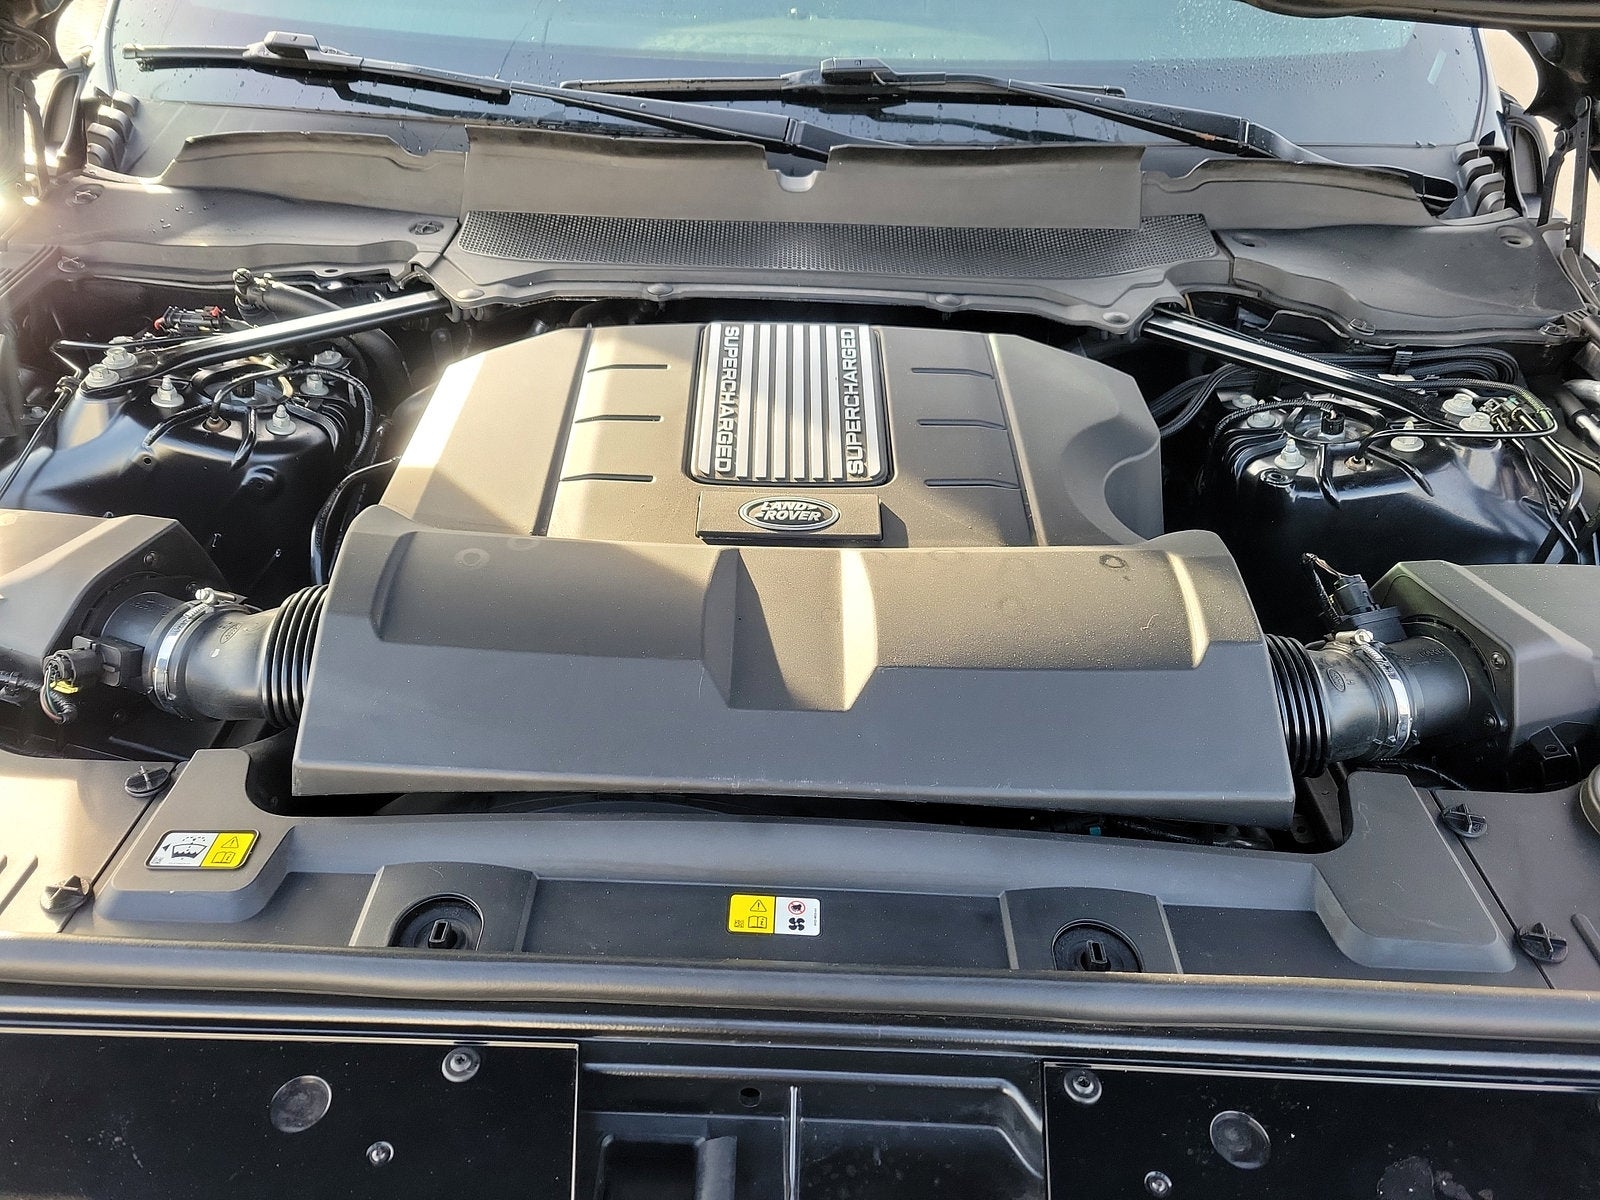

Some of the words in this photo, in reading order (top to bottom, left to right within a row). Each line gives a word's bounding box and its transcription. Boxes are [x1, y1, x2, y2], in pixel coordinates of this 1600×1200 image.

[714, 325, 740, 473] SUPERCHARGED
[840, 328, 864, 475] SUPERCHARGED
[761, 501, 808, 511] LAND
[762, 510, 822, 522] ROVER
